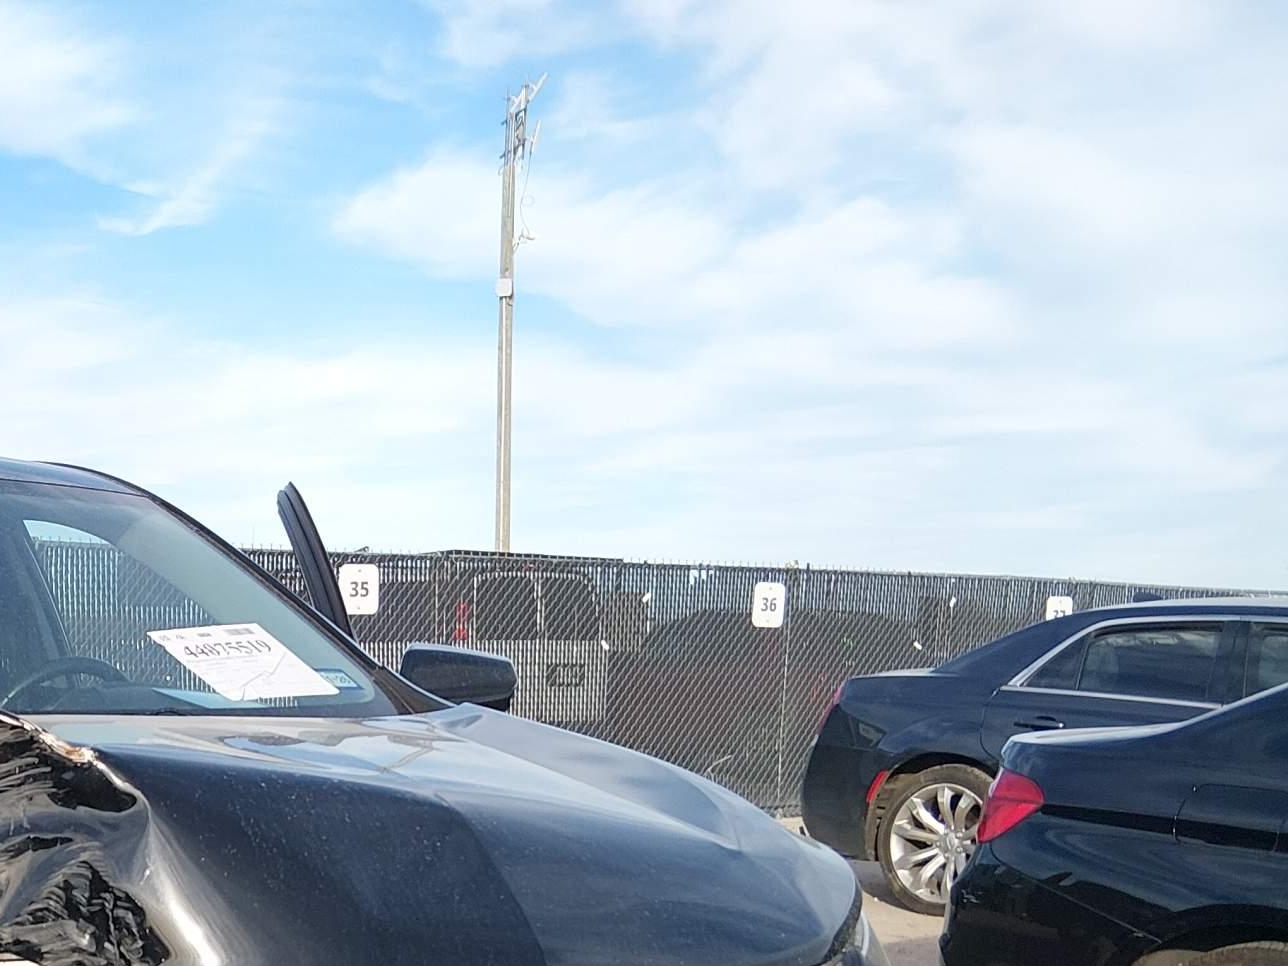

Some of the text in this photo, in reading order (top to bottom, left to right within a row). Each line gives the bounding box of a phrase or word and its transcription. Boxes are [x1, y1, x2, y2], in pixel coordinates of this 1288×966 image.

[349, 582, 369, 597] 35
[760, 597, 777, 612] 36
[184, 640, 271, 658] 44075519
